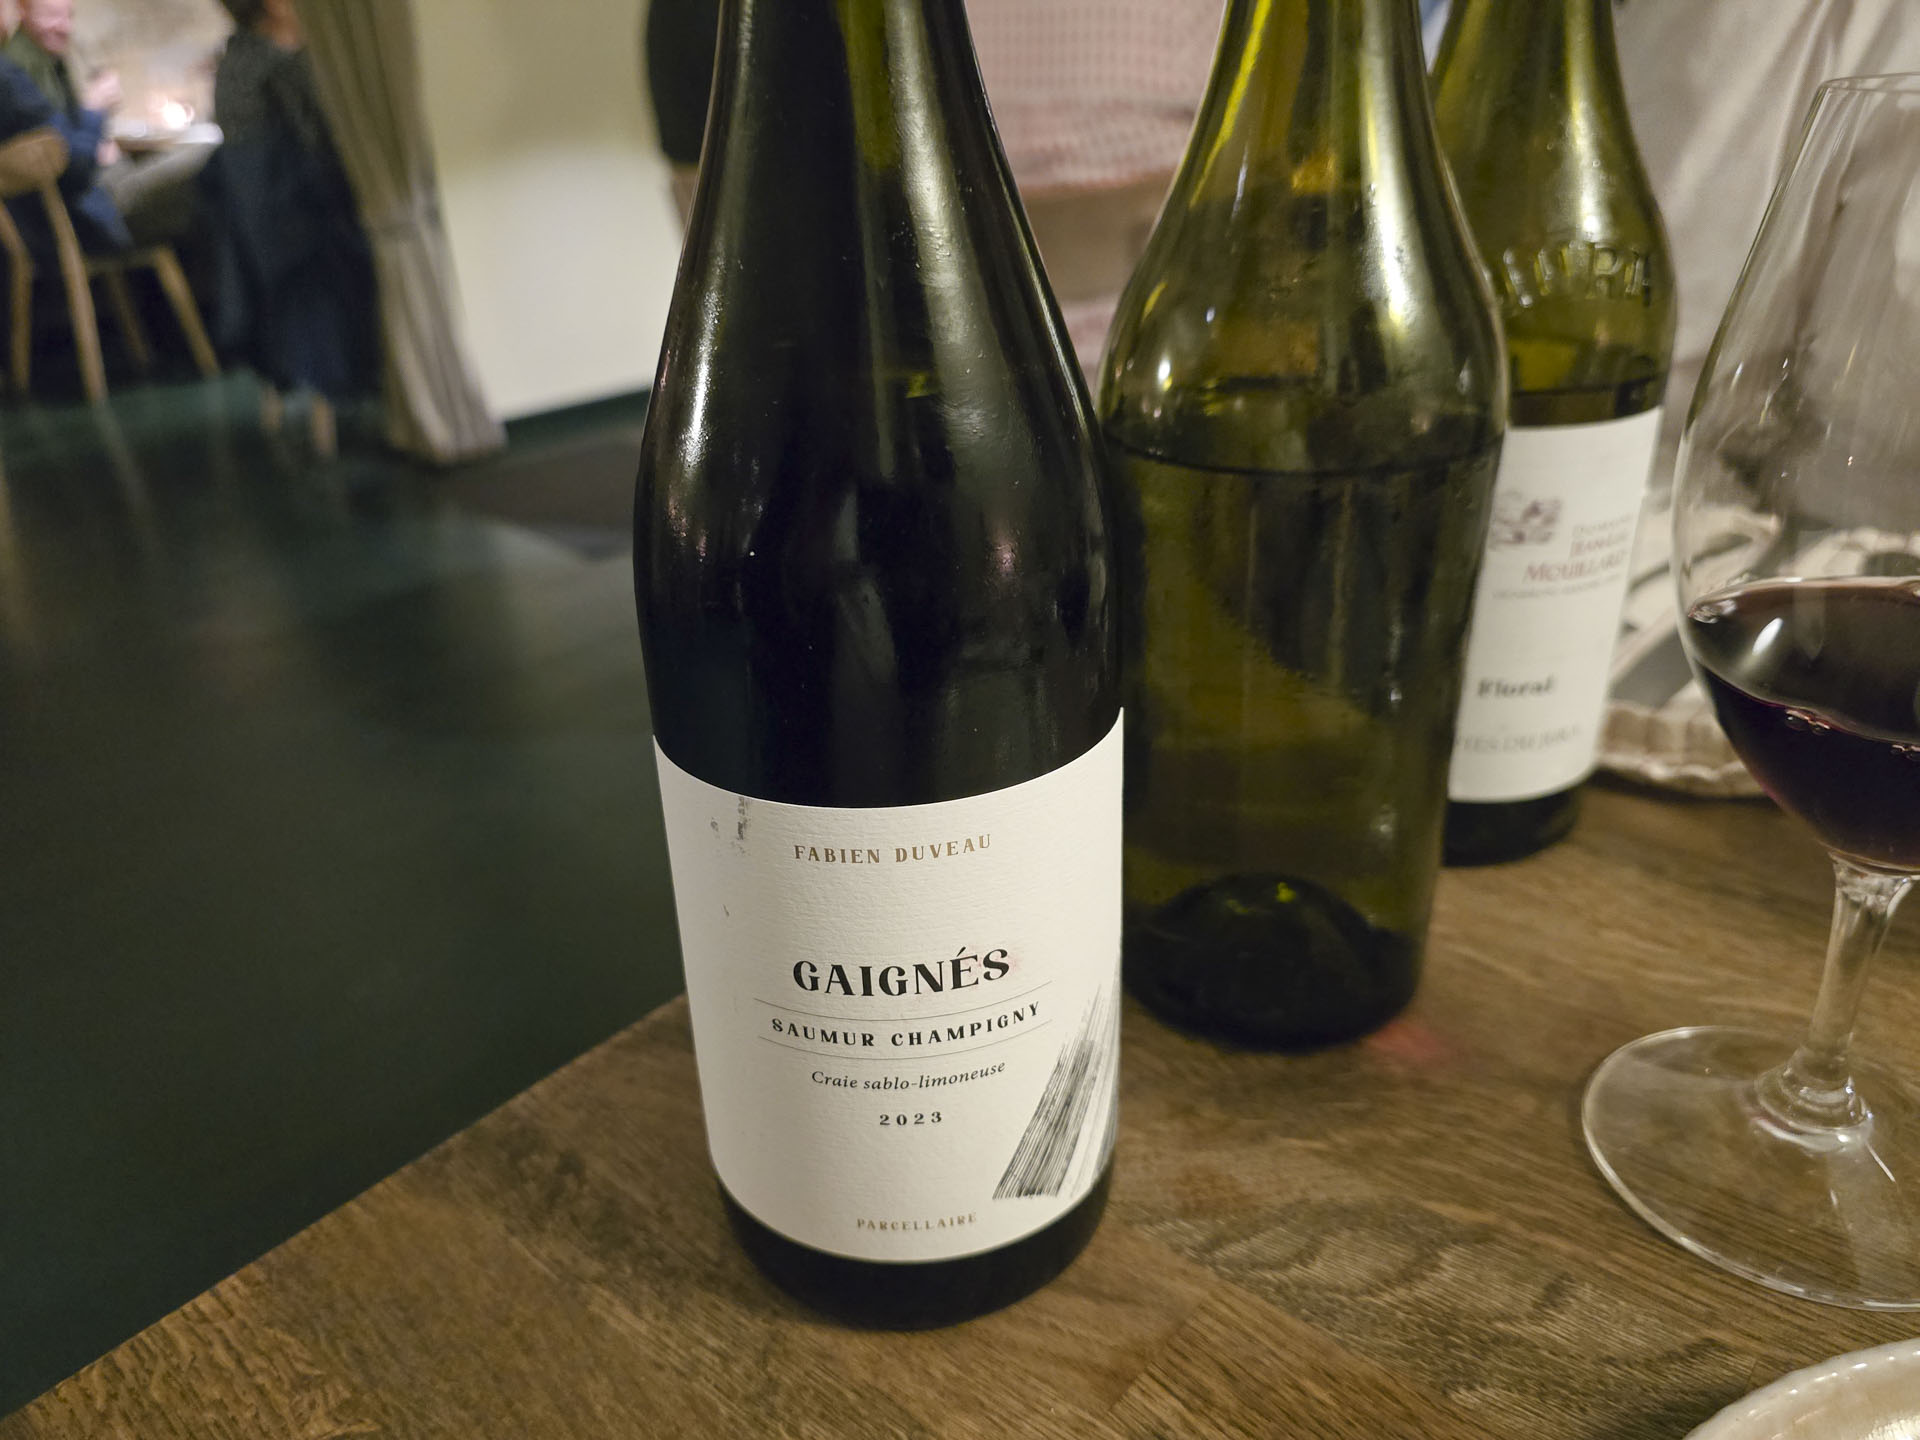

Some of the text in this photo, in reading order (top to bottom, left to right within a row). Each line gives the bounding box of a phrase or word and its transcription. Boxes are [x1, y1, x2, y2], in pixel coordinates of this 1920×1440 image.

[794, 833, 992, 864] FABIEN DUVEAU
[793, 946, 1011, 997] GAIGNÉS
[771, 1001, 1040, 1047] SAUMUR CHAMPIGNY
[811, 1061, 1006, 1091] Craie sablo-limoneuse
[879, 1111, 943, 1127] 2023
[857, 1211, 978, 1232] PARCELLAIRE
